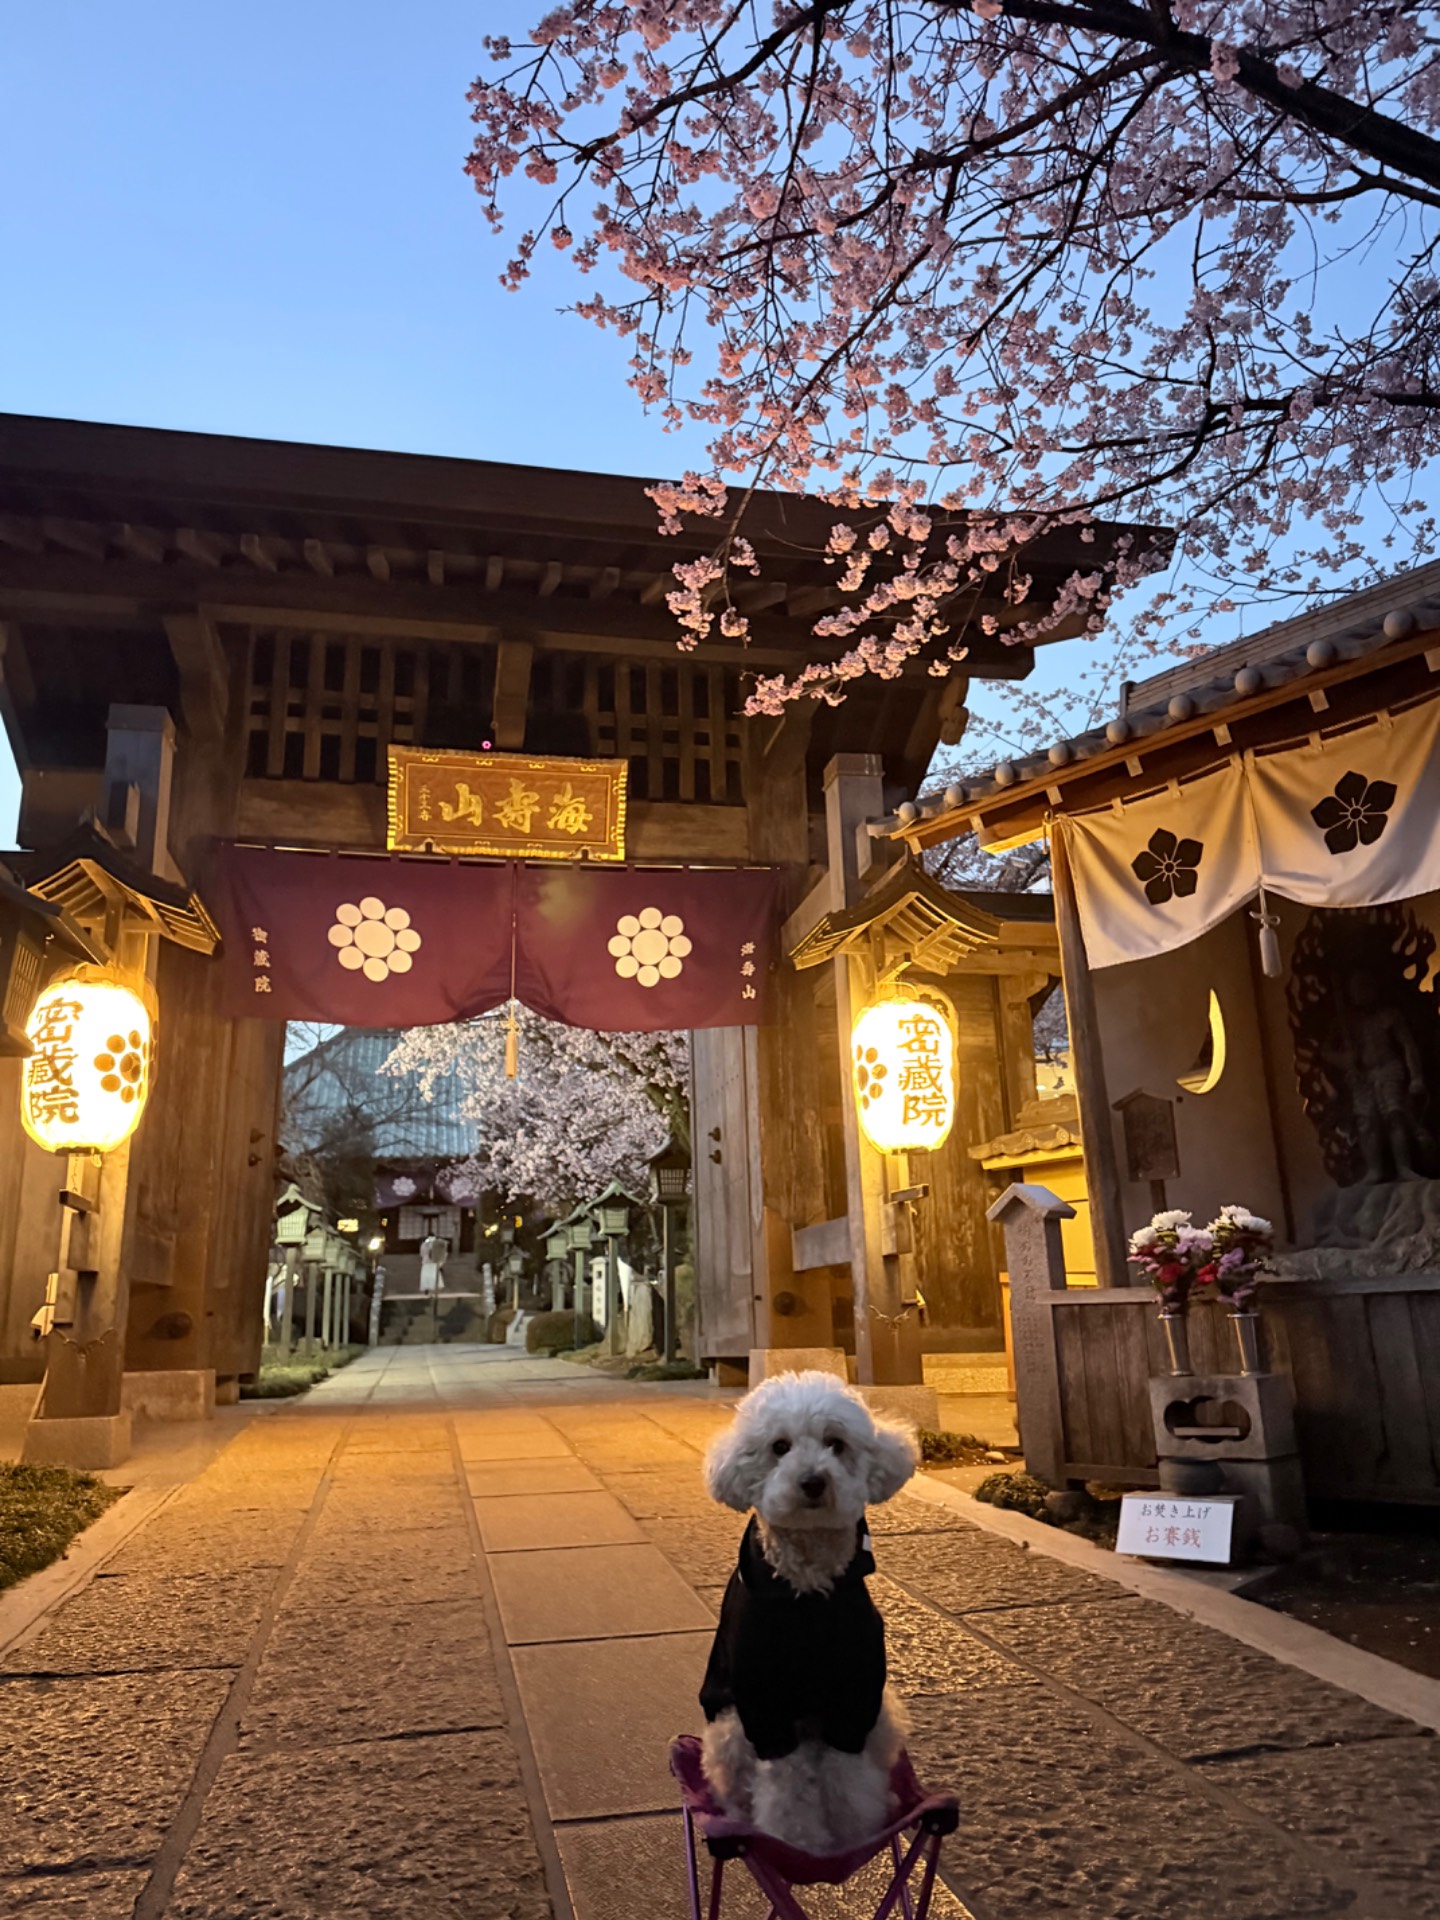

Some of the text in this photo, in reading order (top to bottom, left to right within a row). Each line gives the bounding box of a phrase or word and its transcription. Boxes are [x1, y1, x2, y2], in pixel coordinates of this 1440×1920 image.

[1141, 1503, 1212, 1520] お焚き上げ
[1145, 1525, 1201, 1549] お賽銭
